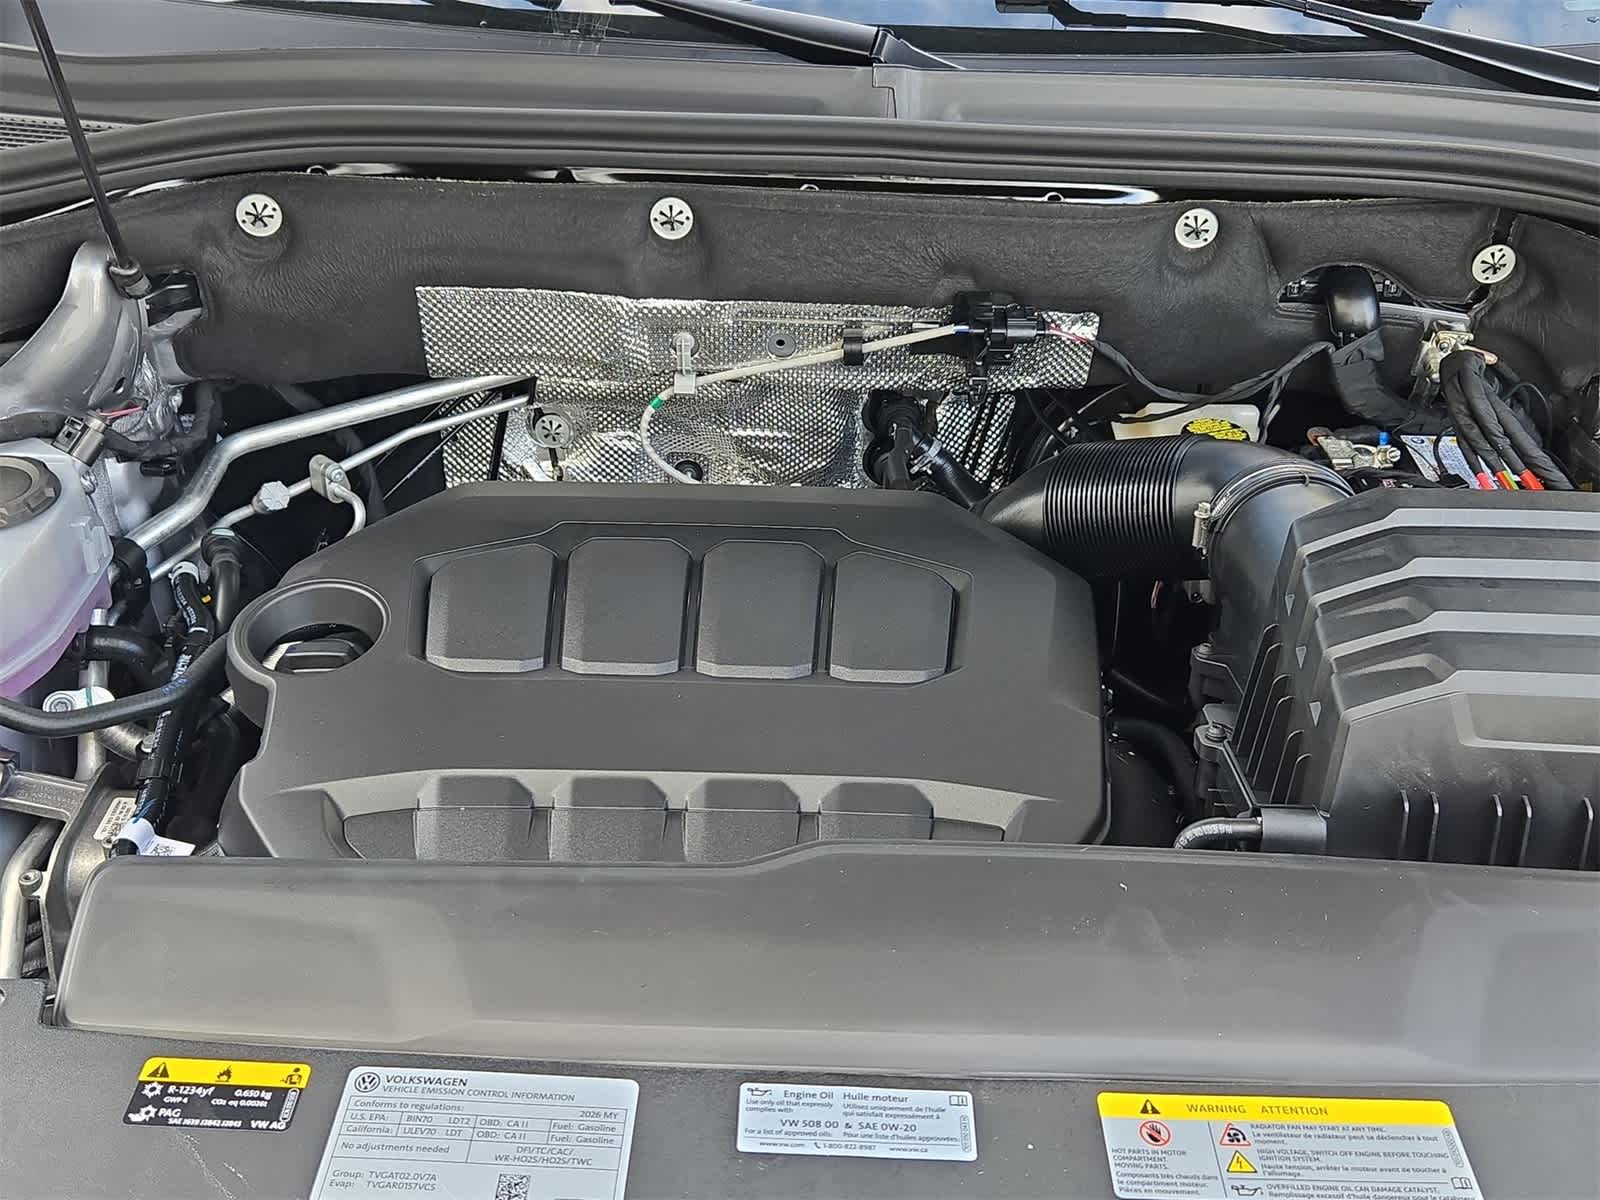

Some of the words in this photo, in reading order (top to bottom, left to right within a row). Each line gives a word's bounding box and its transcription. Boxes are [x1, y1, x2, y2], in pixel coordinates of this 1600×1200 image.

[386, 1075, 468, 1086] VOLKSWAGEN
[167, 1086, 215, 1096] R-1234yf
[234, 1090, 259, 1098] 0.650
[260, 1090, 273, 1100] kg
[383, 1085, 418, 1094] VEHICLE
[421, 1086, 464, 1096] EMISSION
[467, 1089, 508, 1098] CONTROL
[511, 1091, 575, 1102] INFORMATION
[784, 1090, 817, 1100] Engine
[844, 1092, 869, 1100] Huile
[354, 1100, 396, 1108] Conforms
[411, 1102, 464, 1112] regulations:
[1187, 1103, 1246, 1114] WARNING
[1261, 1105, 1328, 1116] ATTENTION
[158, 1108, 181, 1118] PAG
[250, 1120, 269, 1129] VW
[270, 1121, 286, 1130] AG
[406, 1115, 433, 1123] BIN70
[448, 1117, 471, 1125] LDT2
[346, 1125, 392, 1134] California:
[403, 1127, 436, 1136] ULEV70
[445, 1129, 463, 1137] LDT
[578, 1124, 616, 1132] Gasoline
[881, 1123, 917, 1132] 0W-20
[576, 1136, 614, 1144] Gasoline
[356, 1142, 414, 1152] adjustments
[416, 1145, 449, 1153] needed
[333, 1169, 364, 1178] Group:
